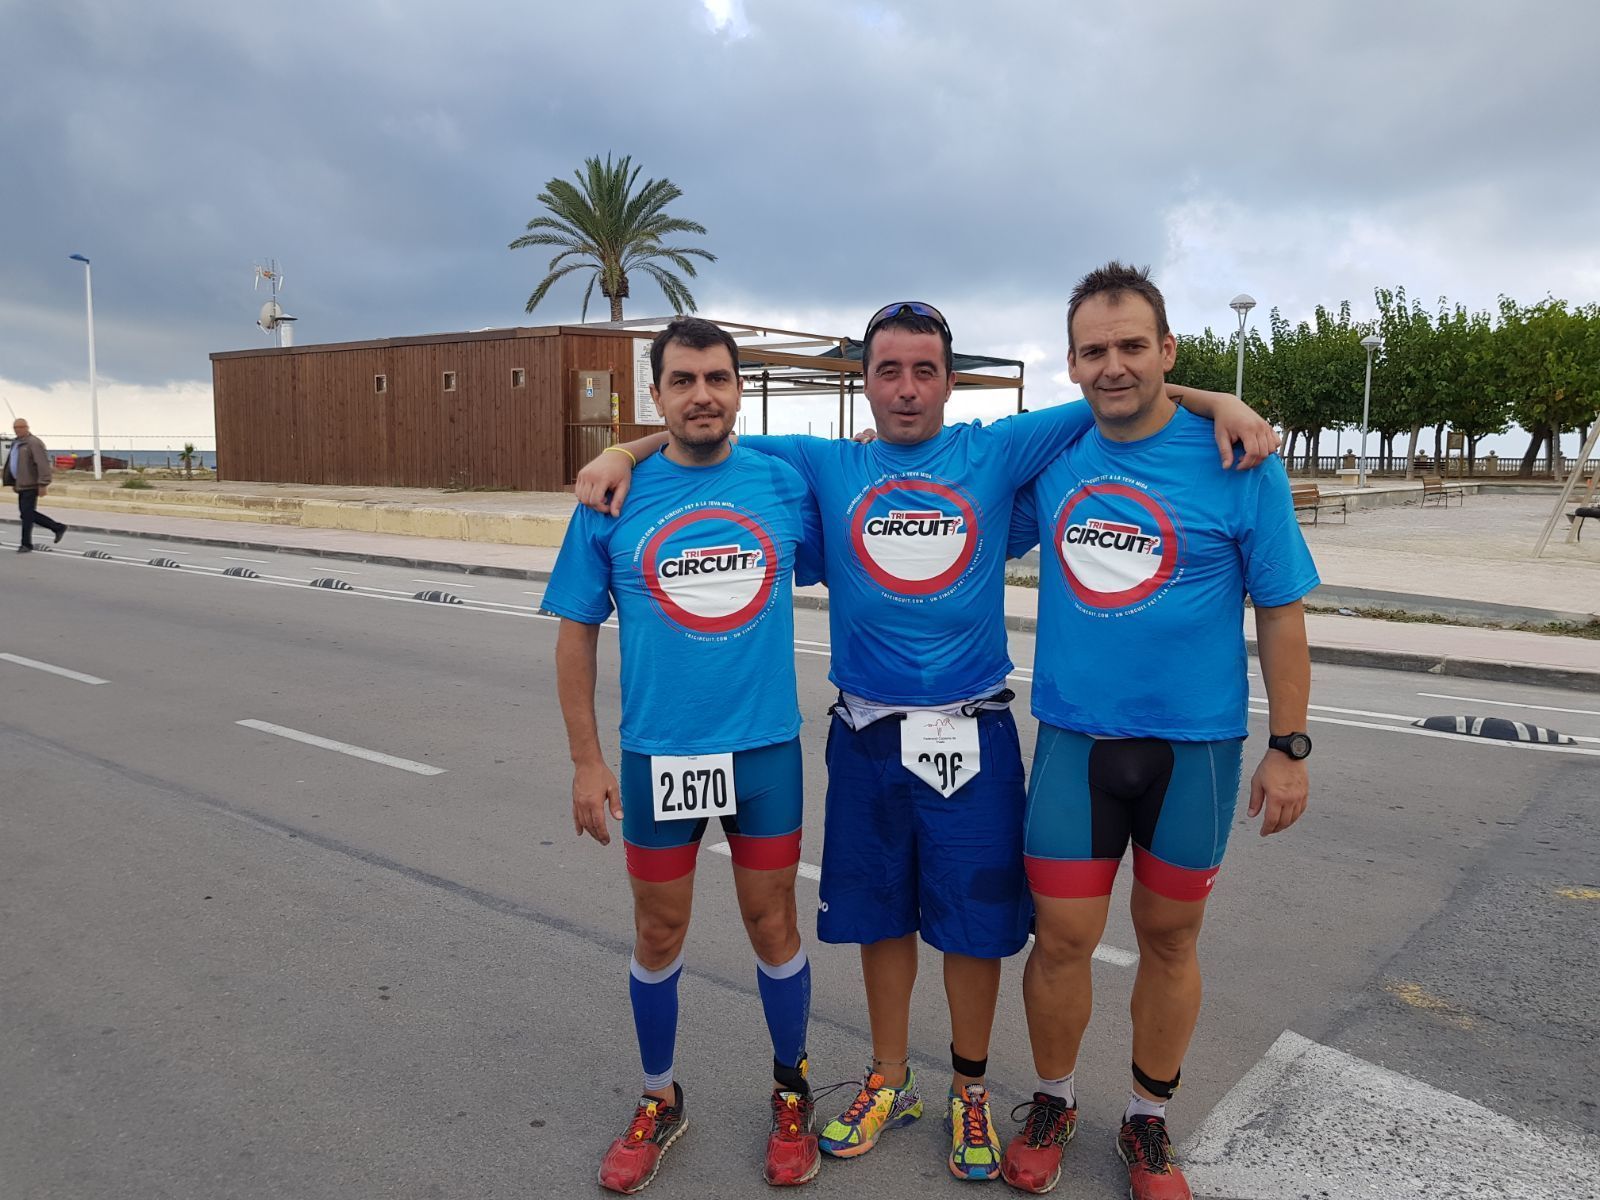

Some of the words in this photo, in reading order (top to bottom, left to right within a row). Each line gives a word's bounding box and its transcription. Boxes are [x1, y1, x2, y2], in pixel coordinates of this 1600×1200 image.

[1122, 476, 1135, 484] TEVA
[665, 508, 684, 520] CIRCUIT
[867, 519, 953, 536] CIRCUIT
[1088, 520, 1103, 530] TRI
[1066, 526, 1150, 553] CIRCUIT
[661, 553, 751, 578] CIRCUIT
[660, 768, 727, 812] 2.670
